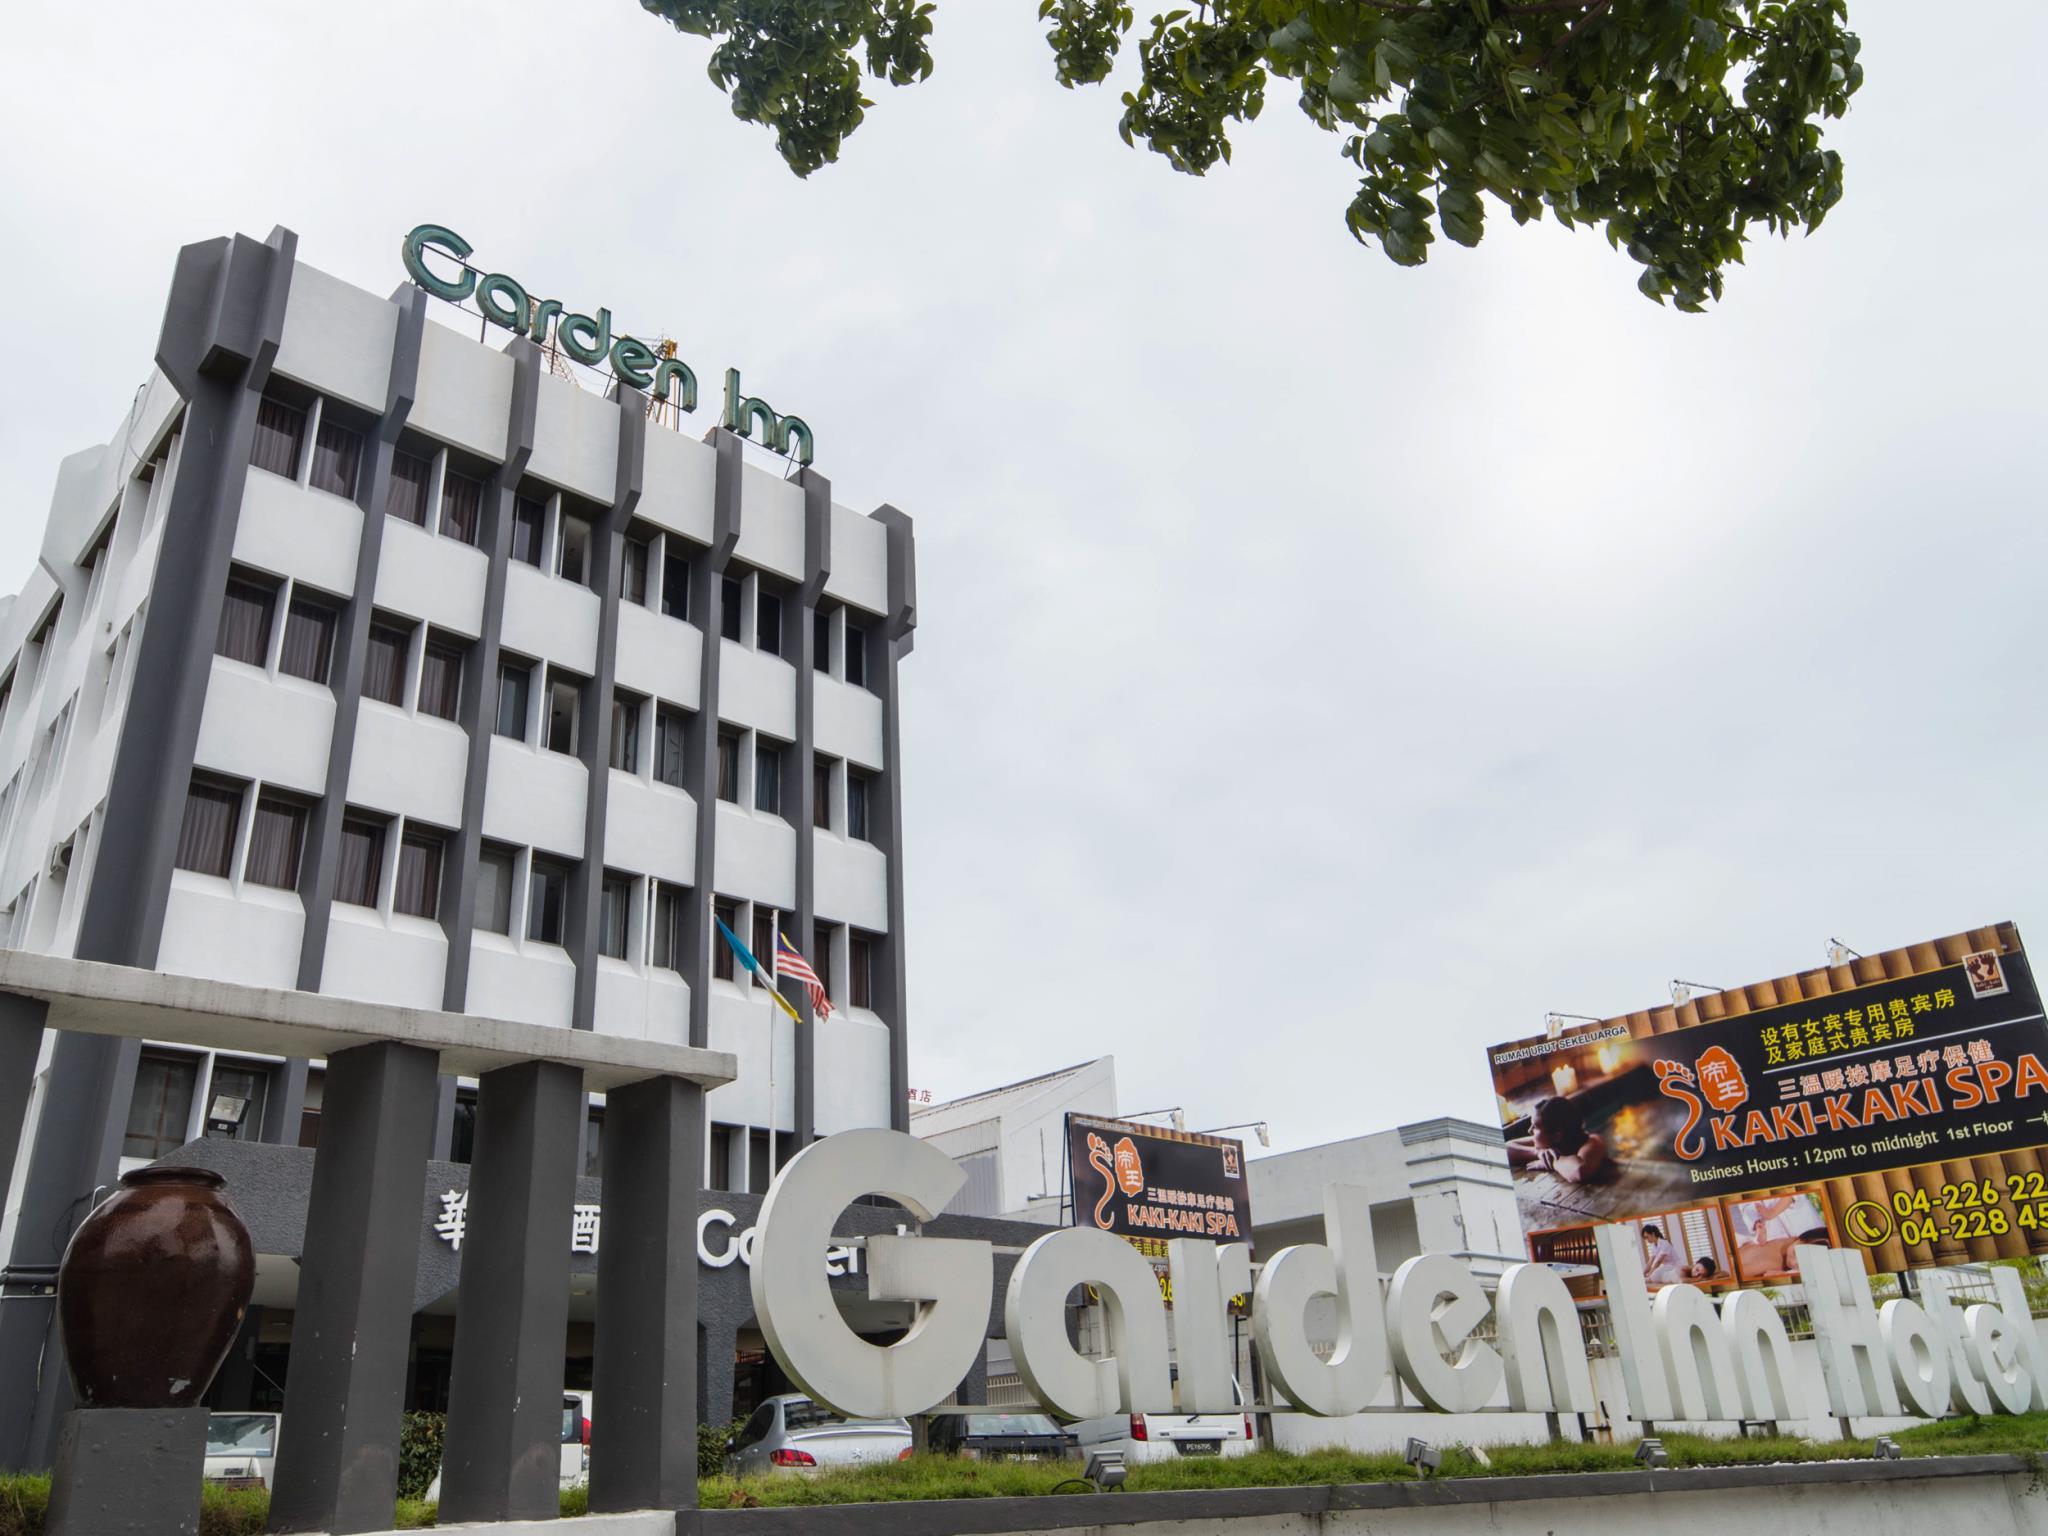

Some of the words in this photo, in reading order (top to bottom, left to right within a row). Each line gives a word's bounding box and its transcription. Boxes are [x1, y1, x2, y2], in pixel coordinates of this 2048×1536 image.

[401, 223, 698, 414] Garden
[723, 367, 815, 467] Inn
[1494, 1047, 1529, 1065] RUMAH
[1530, 1041, 1558, 1057] URUT
[1558, 1025, 1628, 1050] SEKELUARGA
[1760, 988, 1956, 1047] 设有女宾专用贵宾房
[1766, 1017, 1916, 1065] 及家庭式贵宾房
[1777, 1038, 1995, 1101] 三温暖按摩足疗保健
[1710, 1077, 1944, 1151] KAKI-KAKI
[1951, 1053, 2048, 1111] SPA
[1690, 1162, 1744, 1184] Business
[1746, 1155, 1789, 1175] Hours
[1803, 1146, 1848, 1168] 12pm
[1850, 1142, 1868, 1158] to
[1871, 1129, 1940, 1156] midnight
[1946, 1125, 1971, 1142] 1st
[1973, 1118, 2014, 1139] Floor
[1127, 1204, 1205, 1234] KAKI-KAKI
[1206, 1211, 1240, 1237] SPA
[1893, 1178, 2001, 1218] 04-226
[1900, 1206, 2010, 1247] 04-228
[749, 1127, 1596, 1421] Garden
[1593, 1222, 1809, 1424] Inn
[1794, 1243, 2048, 1420] Hotel
